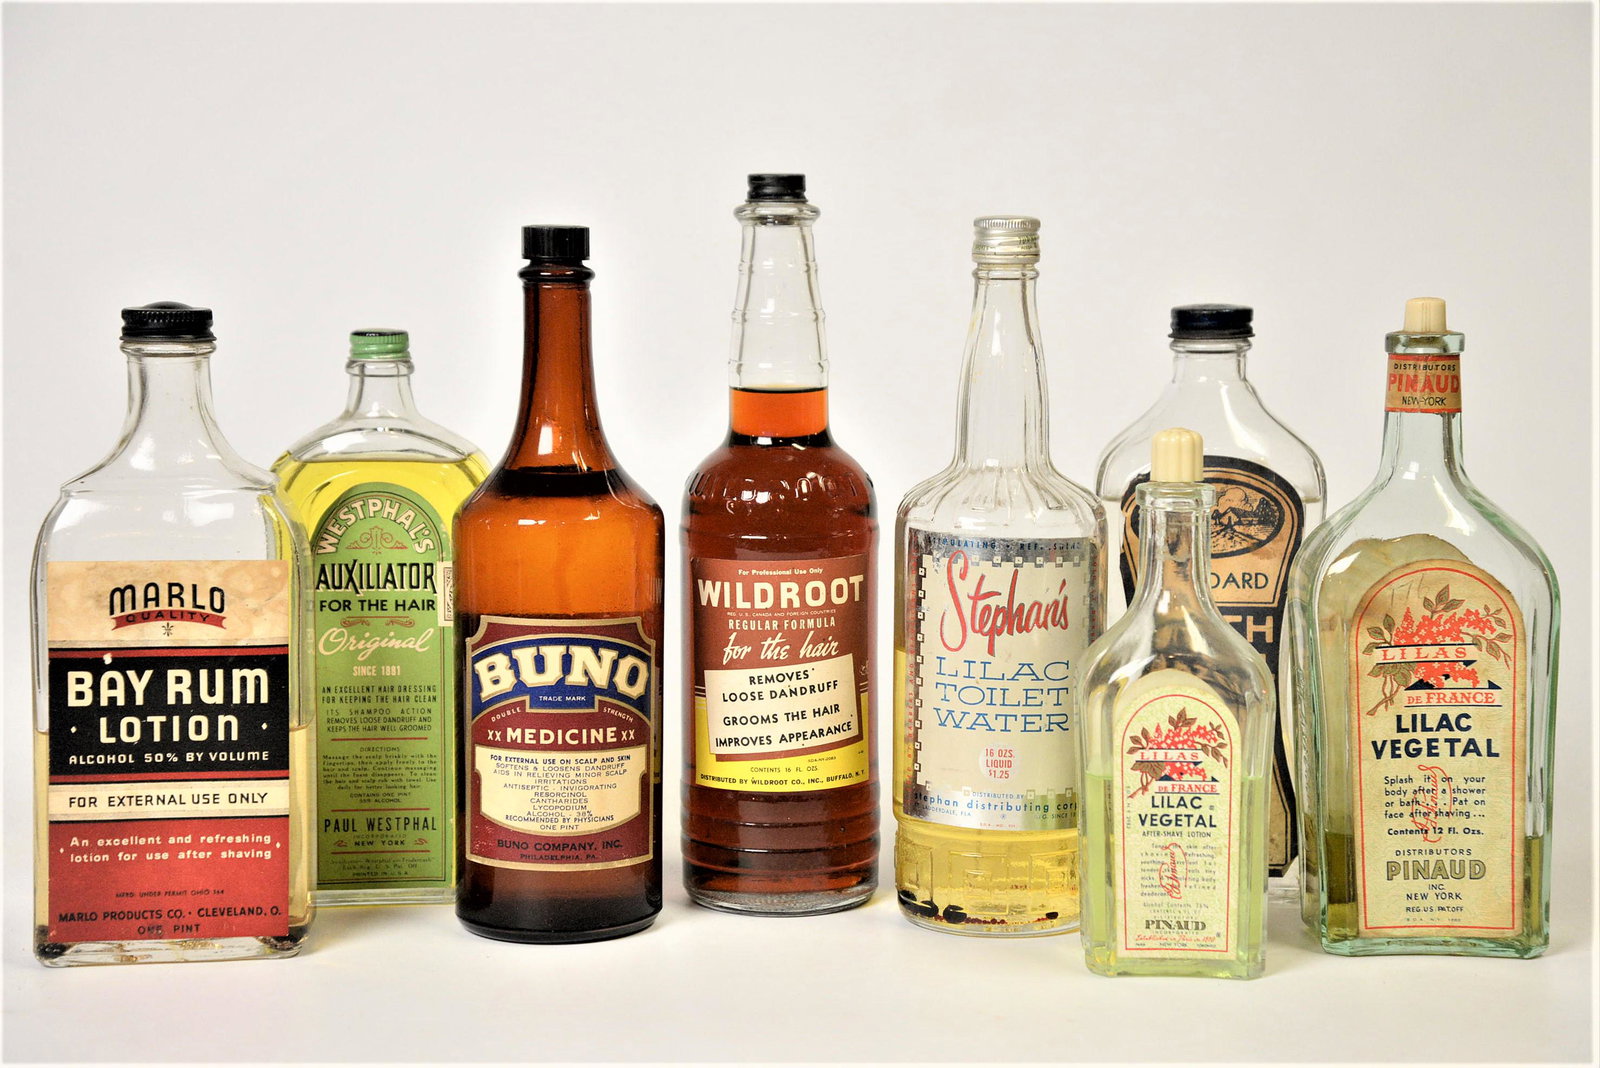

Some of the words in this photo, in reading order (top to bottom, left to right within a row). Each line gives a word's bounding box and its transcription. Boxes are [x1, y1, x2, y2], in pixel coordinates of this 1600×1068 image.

[1394, 363, 1456, 371] DISTRIBUTORS
[1388, 373, 1460, 393] PINAUD
[1402, 396, 1447, 406] NEW-YORK
[316, 498, 436, 556] WESTPHAL'S
[109, 582, 225, 616] MARLO
[698, 575, 864, 609] WILDROOT
[320, 600, 352, 612] FOR
[358, 599, 388, 611] THE
[395, 599, 436, 611] HAIR
[940, 550, 1069, 657] Stephan's
[126, 611, 210, 623] QUALITY
[728, 619, 779, 630] REGULAR
[784, 617, 836, 630] FORMULA
[318, 627, 434, 661] Original
[722, 632, 751, 665] for
[760, 632, 791, 659] the
[799, 630, 839, 659] hair
[1382, 647, 1467, 661] LILAS
[353, 666, 376, 676] SINCE
[382, 665, 400, 676] 1881
[474, 645, 649, 702] BUNO
[936, 656, 1069, 681] LILAC
[749, 669, 809, 685] REMOVES
[67, 669, 153, 707] BAY
[167, 667, 269, 705] RUM
[322, 686, 331, 694] AN
[334, 686, 375, 694] EXCELLENT
[722, 691, 764, 702] LOOSE
[770, 680, 838, 699] DANDRUFF
[935, 682, 1069, 707] TOILET
[1426, 692, 1495, 704] FRANCE
[491, 707, 521, 722] DOUBLE
[603, 707, 634, 722] STRENGTH
[723, 714, 779, 726] GROOMS
[784, 710, 807, 722] THE
[813, 703, 840, 718] HAIR
[933, 708, 1069, 732] WATER
[100, 714, 238, 744] LOTION
[1396, 713, 1472, 733] LILAC
[507, 727, 617, 745] MEDICINE
[715, 735, 772, 747] IMPROVES
[779, 721, 852, 744] APPEARANCE
[985, 748, 994, 758] 16
[998, 749, 1015, 758] OZS.
[1371, 738, 1499, 759] VEGETAL
[69, 754, 135, 765] ALCOHOL
[144, 753, 179, 763] 50%
[186, 752, 204, 762] BY
[209, 751, 270, 761] VOLUME
[505, 756, 538, 764] EXTERNAL
[1140, 752, 1199, 760] LILAS
[986, 759, 1012, 769] LIQUID
[701, 774, 737, 783] DISTRIBUTED
[989, 770, 1010, 779] $1.25
[1384, 775, 1413, 786] Splash
[973, 791, 1014, 799] DISTRIBUTED
[1171, 784, 1217, 792] FRANCE
[1385, 787, 1407, 797] body
[1413, 786, 1435, 795] after
[1452, 785, 1485, 794] shower
[69, 796, 98, 808] FOR
[107, 794, 187, 807] EXTERNAL
[192, 794, 220, 805] USE
[228, 792, 268, 804] ONLY
[914, 791, 958, 807] stephan
[967, 800, 1049, 813] distributing
[1151, 796, 1203, 809] LILAC
[1453, 797, 1468, 805] Pat
[505, 815, 558, 823] RECOMMENDED
[1138, 813, 1217, 828] VEGETAL
[1384, 810, 1404, 818] face
[1409, 809, 1431, 817] after
[324, 819, 357, 832] PAUL
[366, 817, 436, 832] WESTPHAL
[70, 837, 89, 847] An
[97, 836, 162, 846] excellent
[168, 835, 192, 844] and
[200, 834, 272, 845] refreshing
[497, 840, 529, 850] BUNO
[602, 839, 623, 849] INC.
[70, 853, 109, 863] lotion
[118, 852, 138, 861] for
[146, 851, 170, 860] use
[178, 850, 212, 859] after
[220, 850, 272, 860] shaving
[1386, 859, 1486, 881] PINAUD
[1406, 892, 1428, 900] NEW
[1435, 892, 1462, 900] YORK
[58, 912, 98, 923] MARLO
[103, 910, 163, 920] PRODUCTS
[167, 909, 185, 919] CO.
[271, 905, 282, 916] O.
[173, 924, 201, 933] PINT
[1145, 920, 1206, 930] PINAUD
